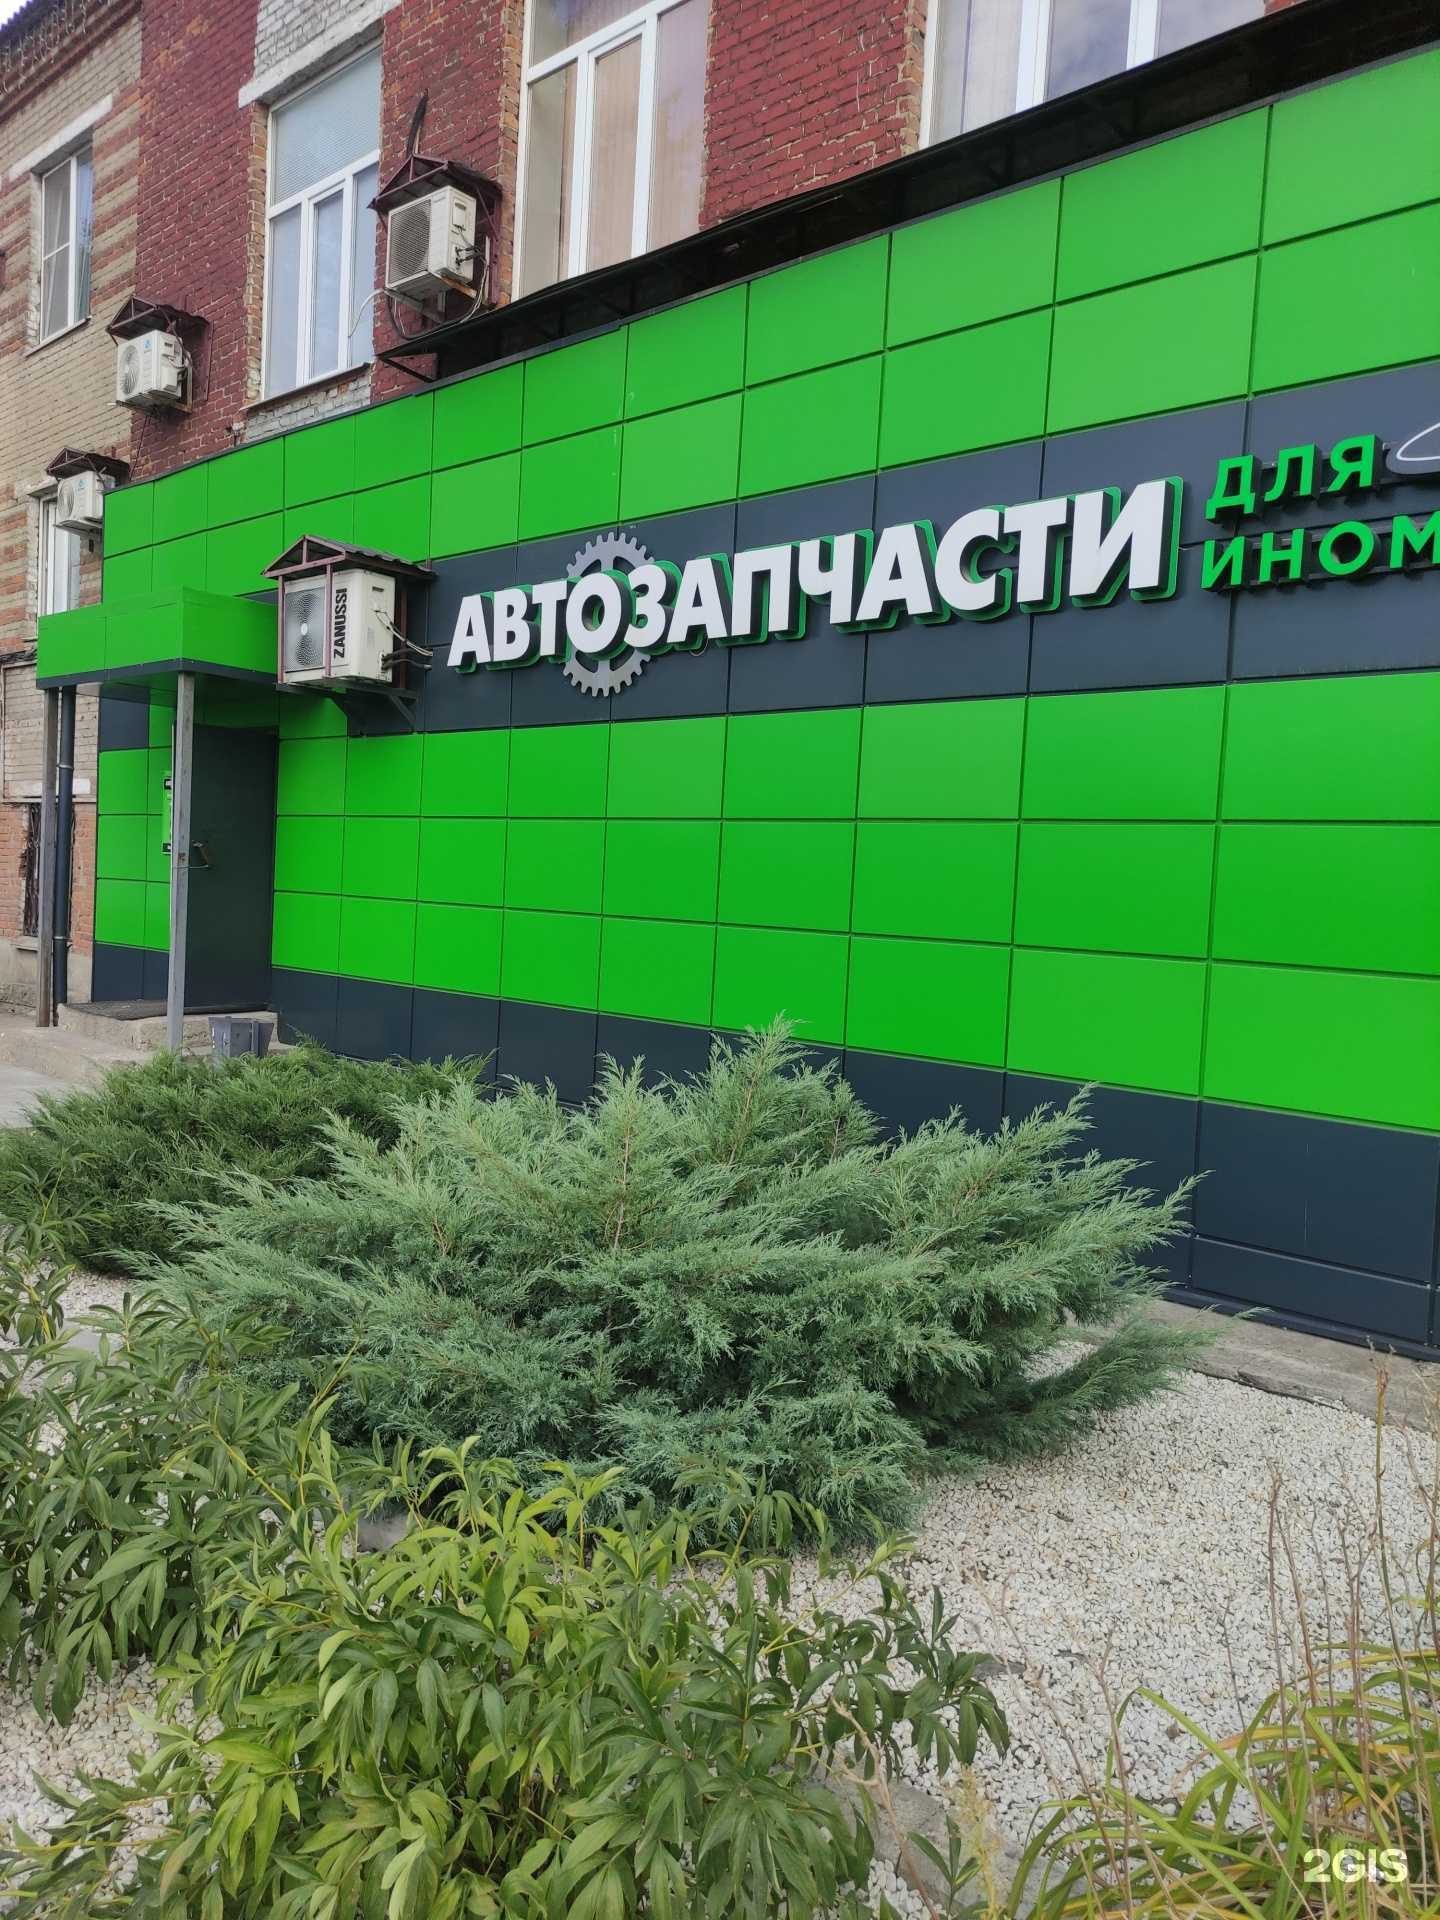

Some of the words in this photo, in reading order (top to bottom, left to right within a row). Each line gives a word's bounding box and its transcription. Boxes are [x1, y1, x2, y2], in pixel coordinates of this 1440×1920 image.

[1205, 433, 1377, 520] ДЛЯ
[447, 478, 1178, 668] АВТОЗАПЧАСТИ
[1201, 510, 1440, 589] ИНОМ
[333, 587, 348, 660] ZANUSSI
